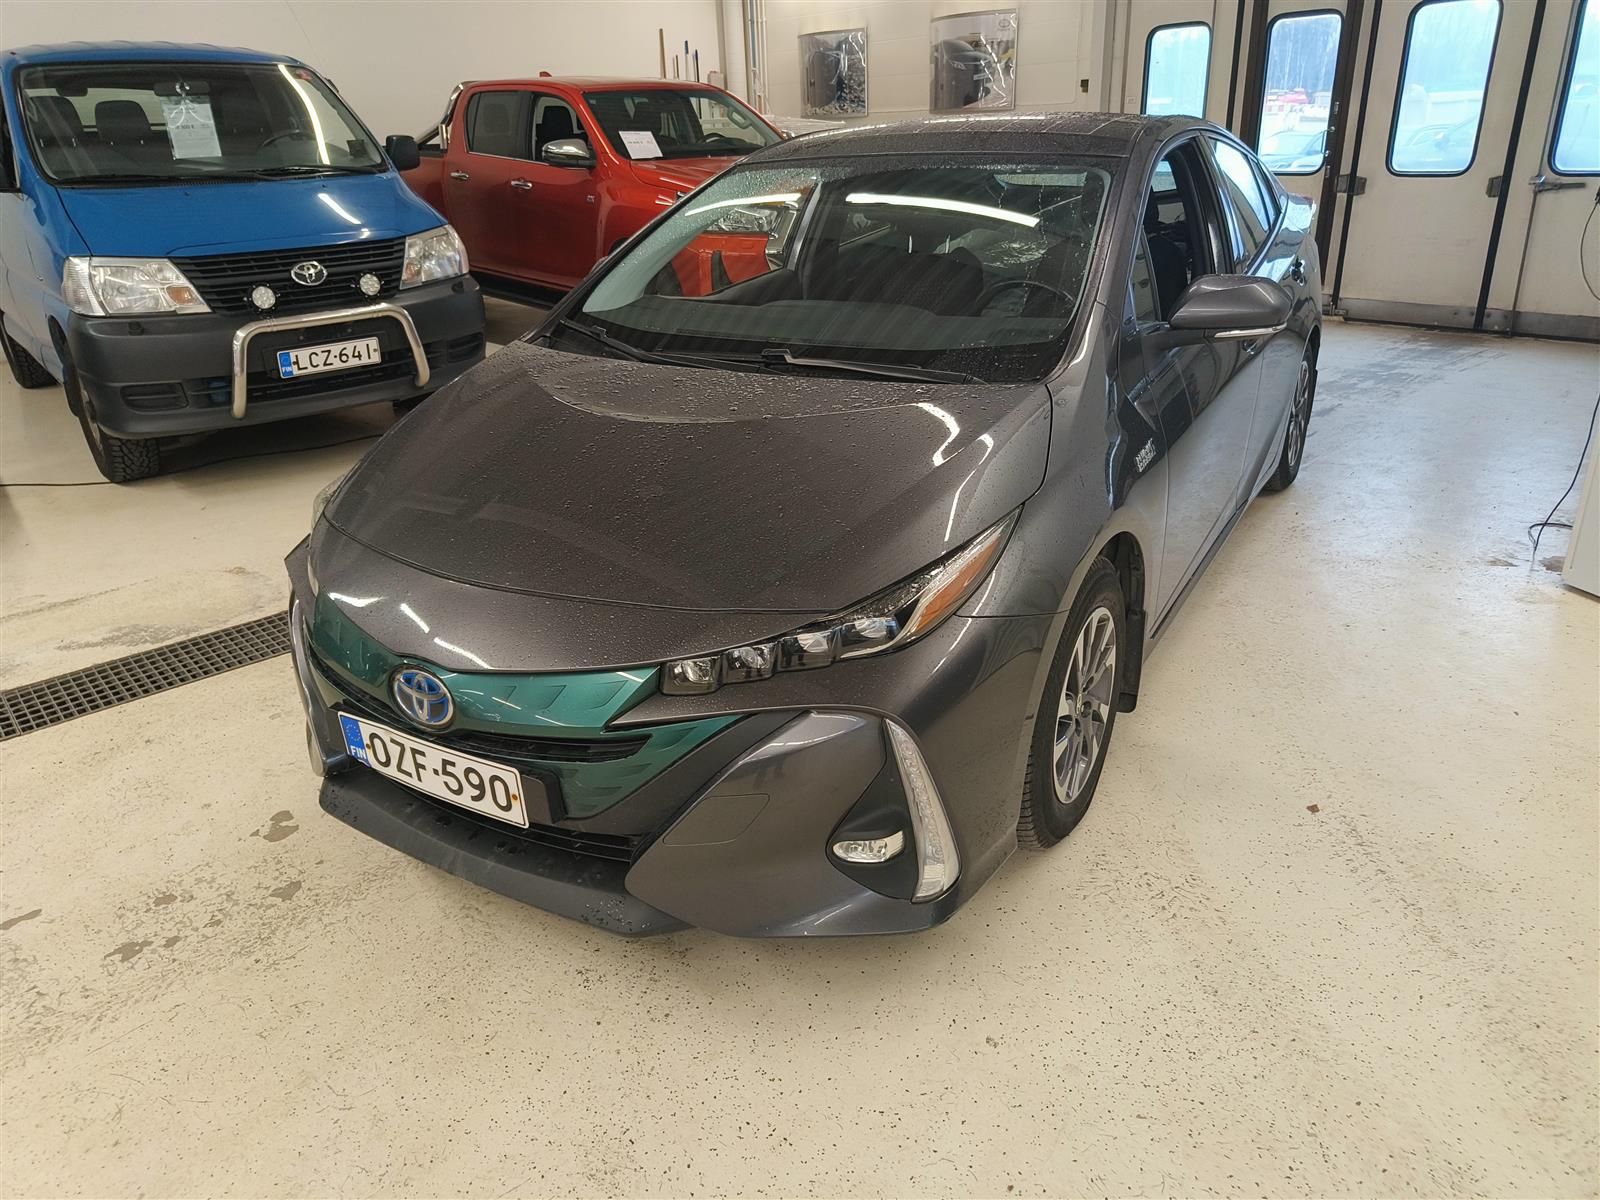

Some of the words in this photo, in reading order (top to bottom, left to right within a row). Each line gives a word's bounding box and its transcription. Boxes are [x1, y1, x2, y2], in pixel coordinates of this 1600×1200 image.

[295, 343, 371, 371] LCZ-641
[350, 745, 367, 760] FIN
[368, 732, 513, 813] OZF-590
